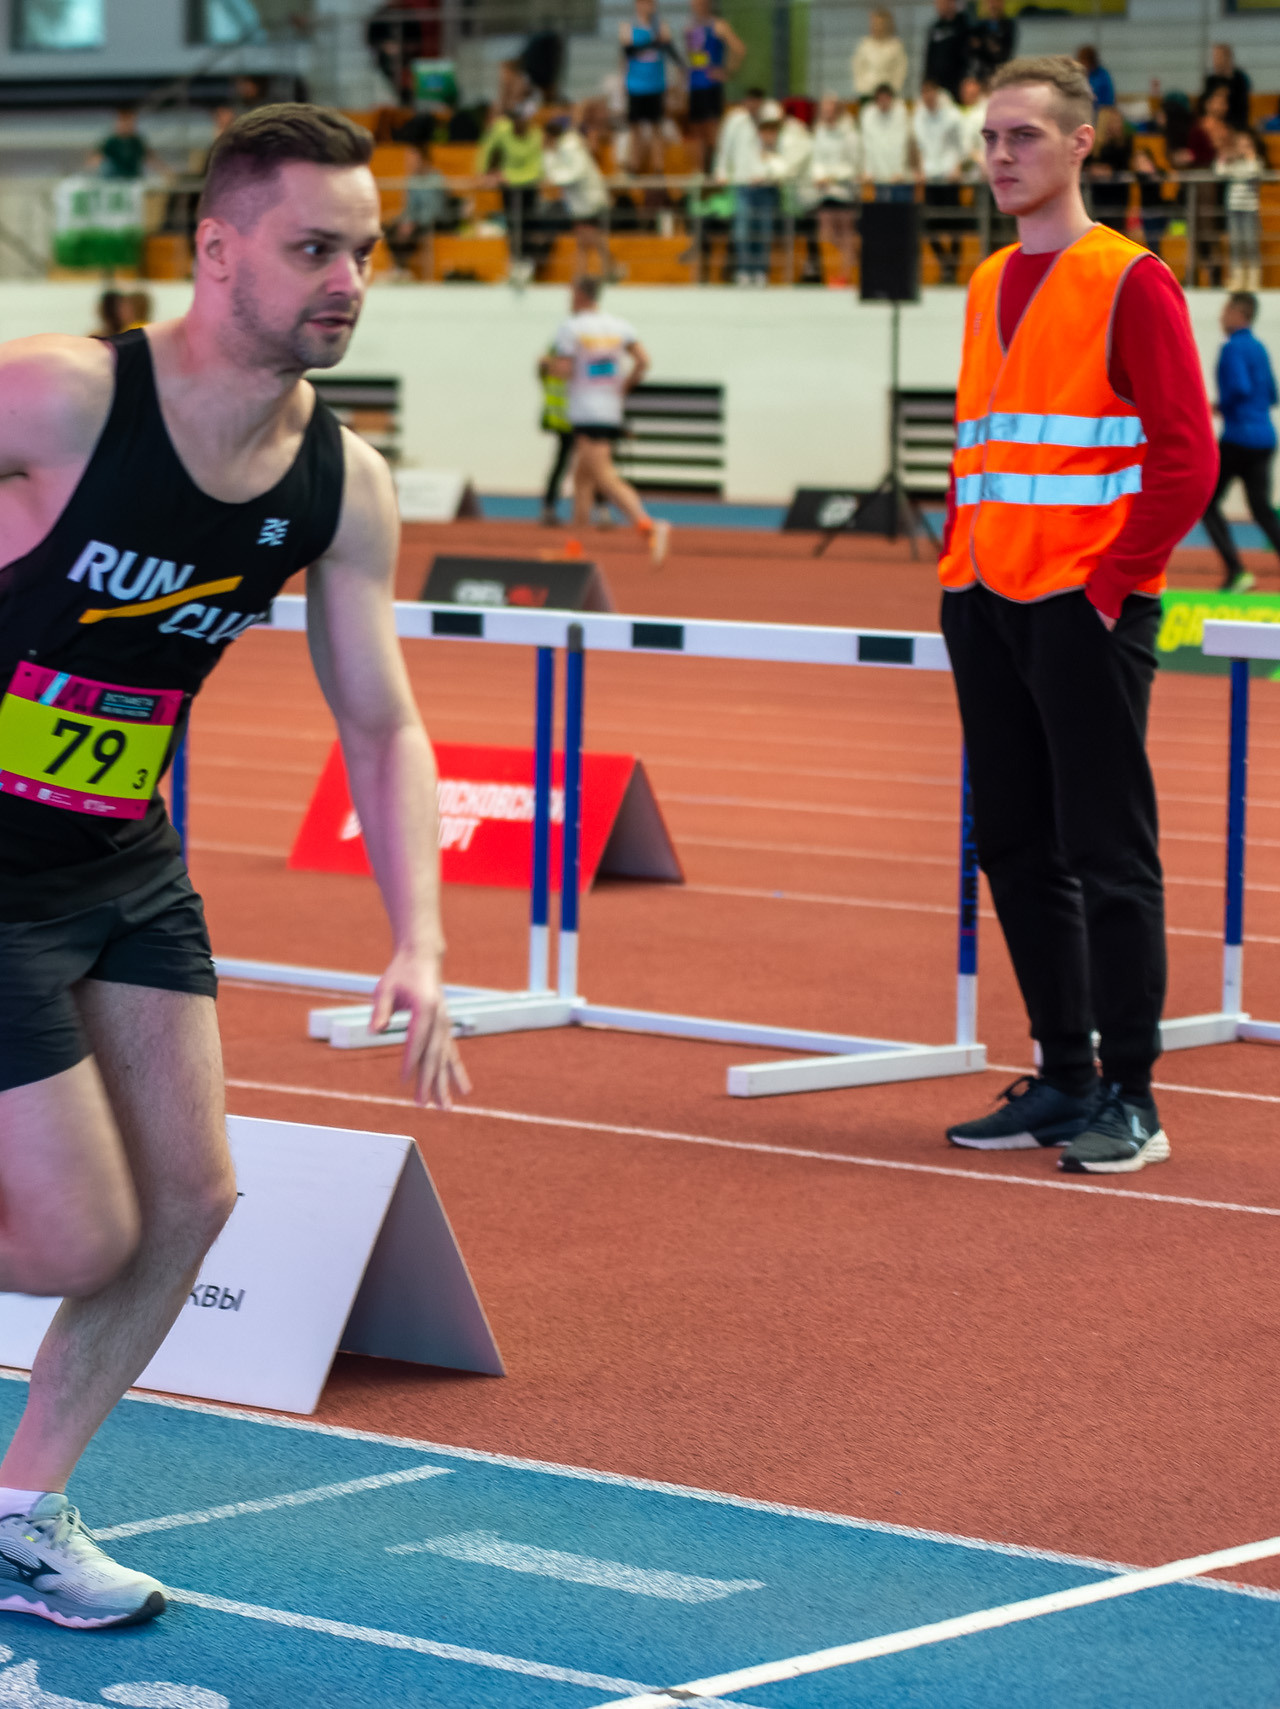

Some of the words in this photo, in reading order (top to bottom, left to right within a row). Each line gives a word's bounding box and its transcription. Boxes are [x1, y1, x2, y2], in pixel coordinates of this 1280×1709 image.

[67, 540, 196, 601] RUN
[43, 717, 128, 785] 79
[132, 768, 149, 790] 3
